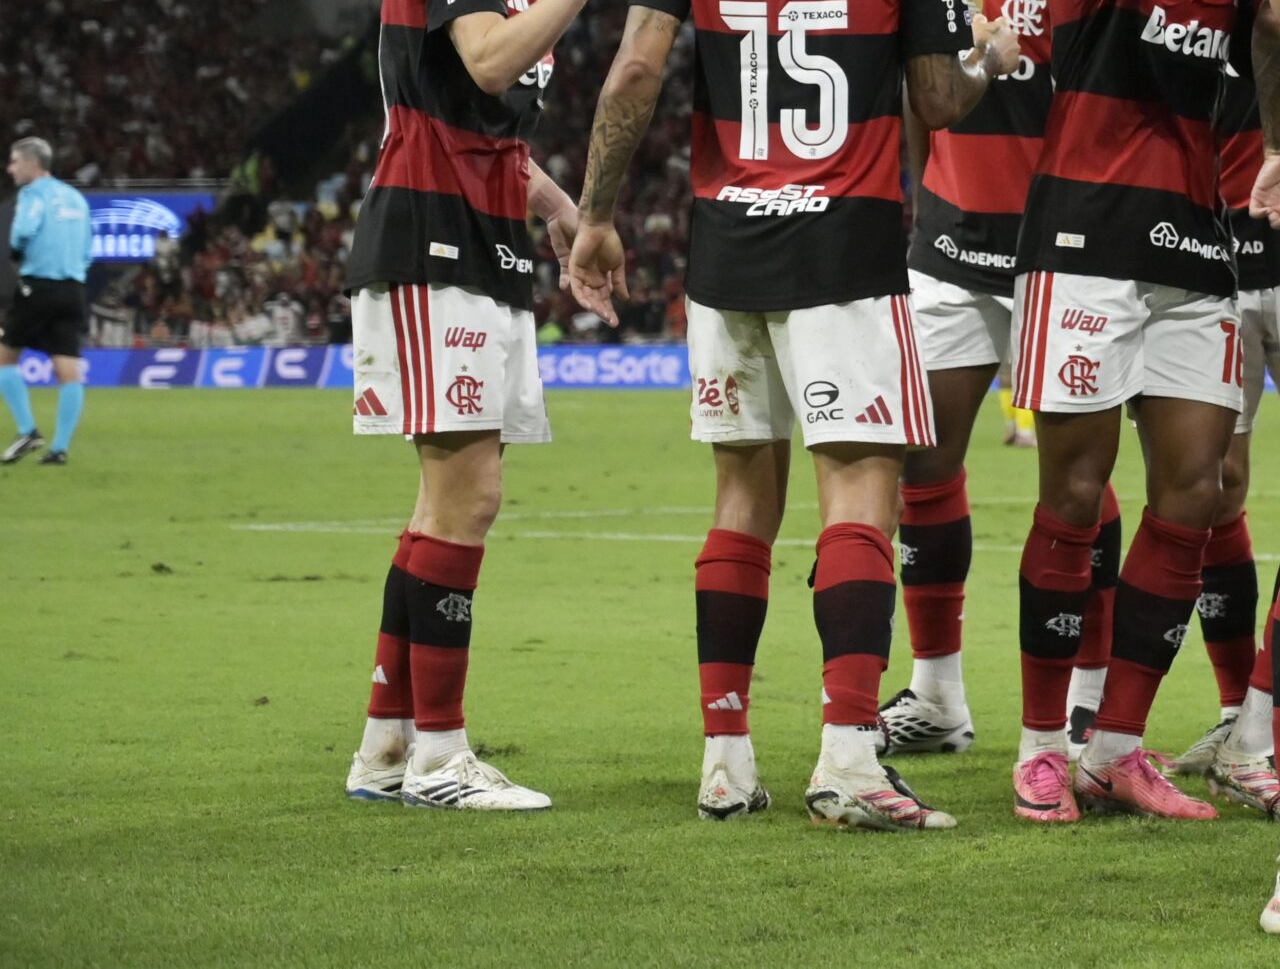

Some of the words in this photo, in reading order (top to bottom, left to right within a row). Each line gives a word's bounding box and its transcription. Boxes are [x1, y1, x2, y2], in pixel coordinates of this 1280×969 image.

[802, 10, 843, 21] TEXACO
[719, 0, 849, 161] 15
[750, 51, 758, 95] TEXACO
[746, 196, 830, 217] CARD
[960, 248, 1018, 269] ADEMICO
[1061, 308, 1108, 336] Wap
[445, 327, 487, 352] Wap
[598, 348, 682, 385] Sorte
[807, 408, 845, 424] GAC
